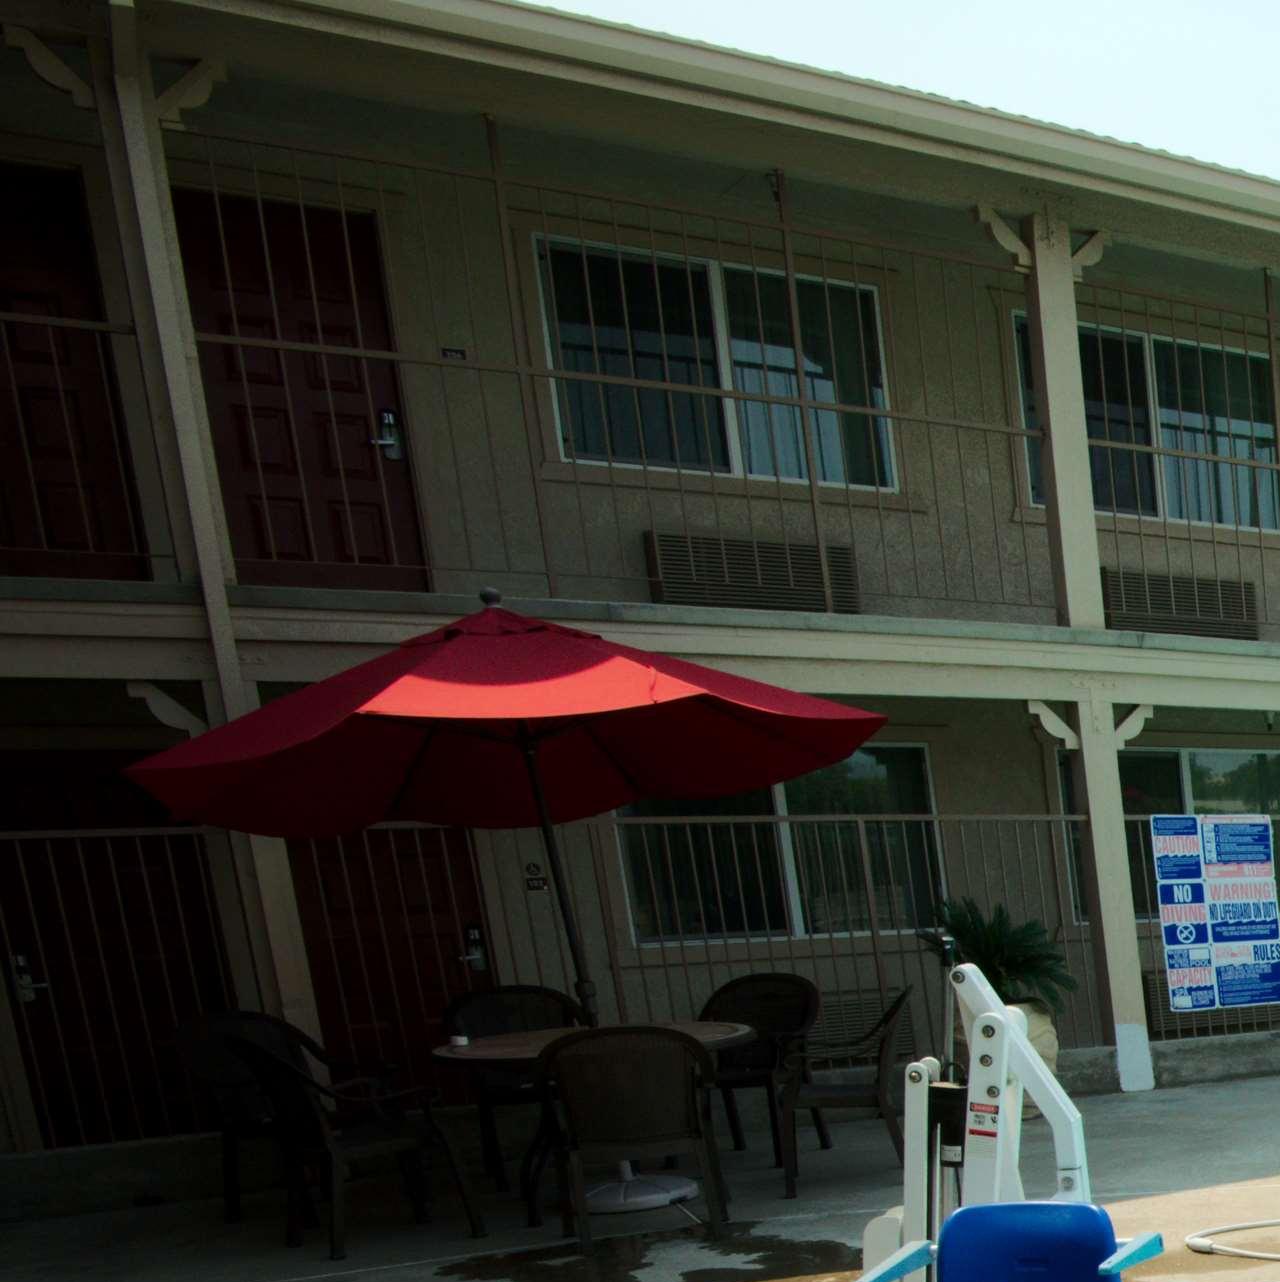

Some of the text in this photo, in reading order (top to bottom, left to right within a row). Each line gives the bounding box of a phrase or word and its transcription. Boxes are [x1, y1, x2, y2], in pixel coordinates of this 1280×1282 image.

[1155, 836, 1200, 854] CAUTION
[1173, 884, 1192, 903] NO
[1161, 905, 1206, 923] DIVING
[1209, 901, 1277, 921] NO LIFEGUARD ON DUTY
[1253, 944, 1280, 961] RULES
[1169, 968, 1212, 986] CAPACITY
